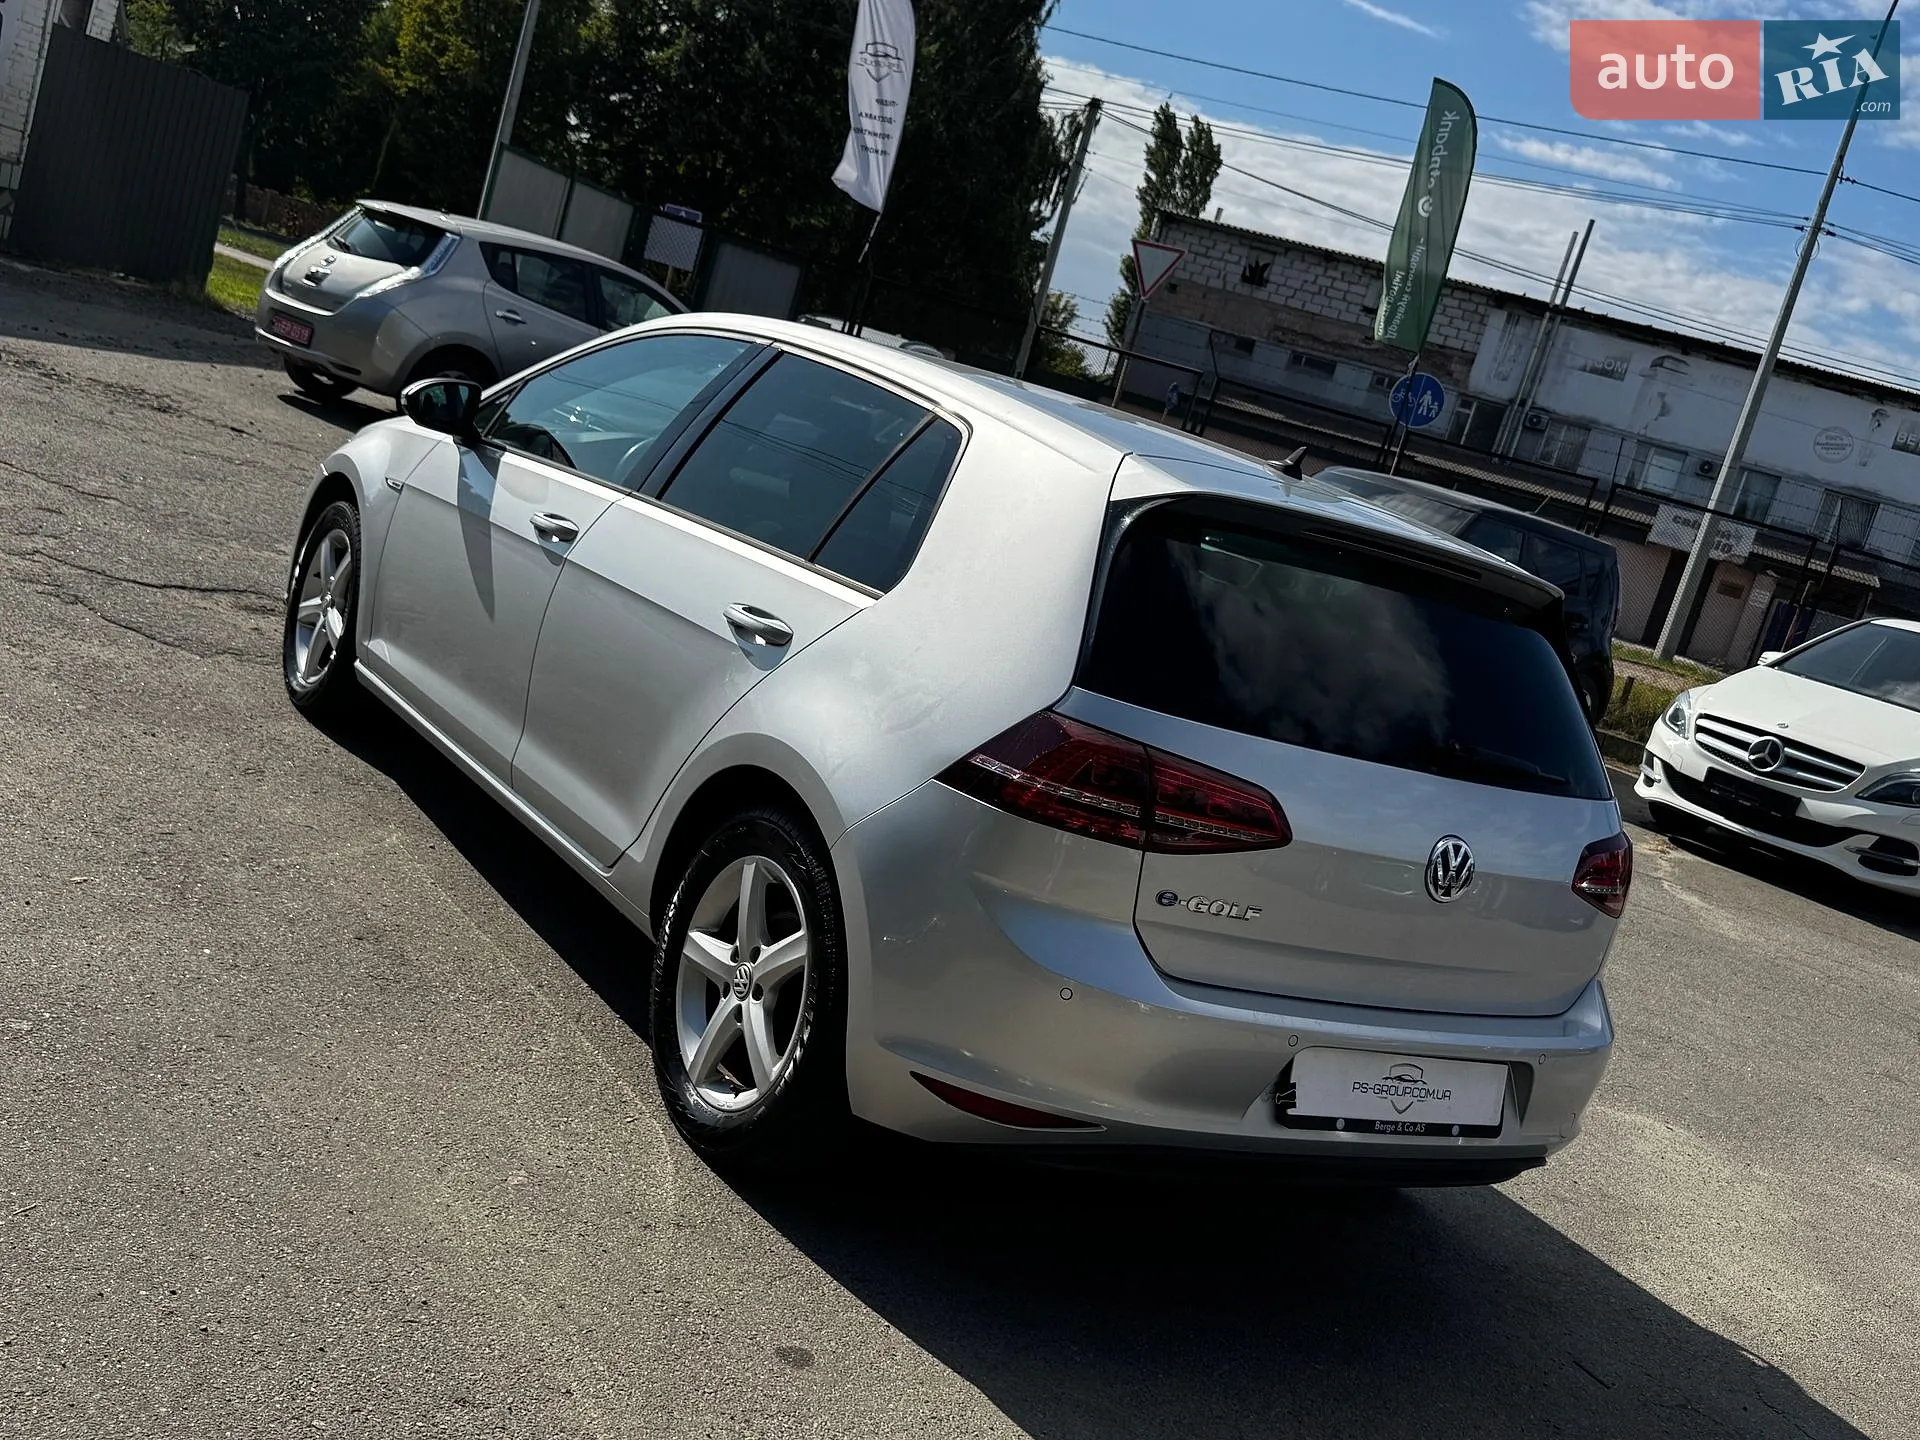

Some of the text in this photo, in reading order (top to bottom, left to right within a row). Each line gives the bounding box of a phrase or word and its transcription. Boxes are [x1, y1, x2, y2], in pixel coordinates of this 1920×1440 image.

[1156, 889, 1263, 921] e-GOLF
[1374, 1120, 1426, 1133] Berge & Co AS
